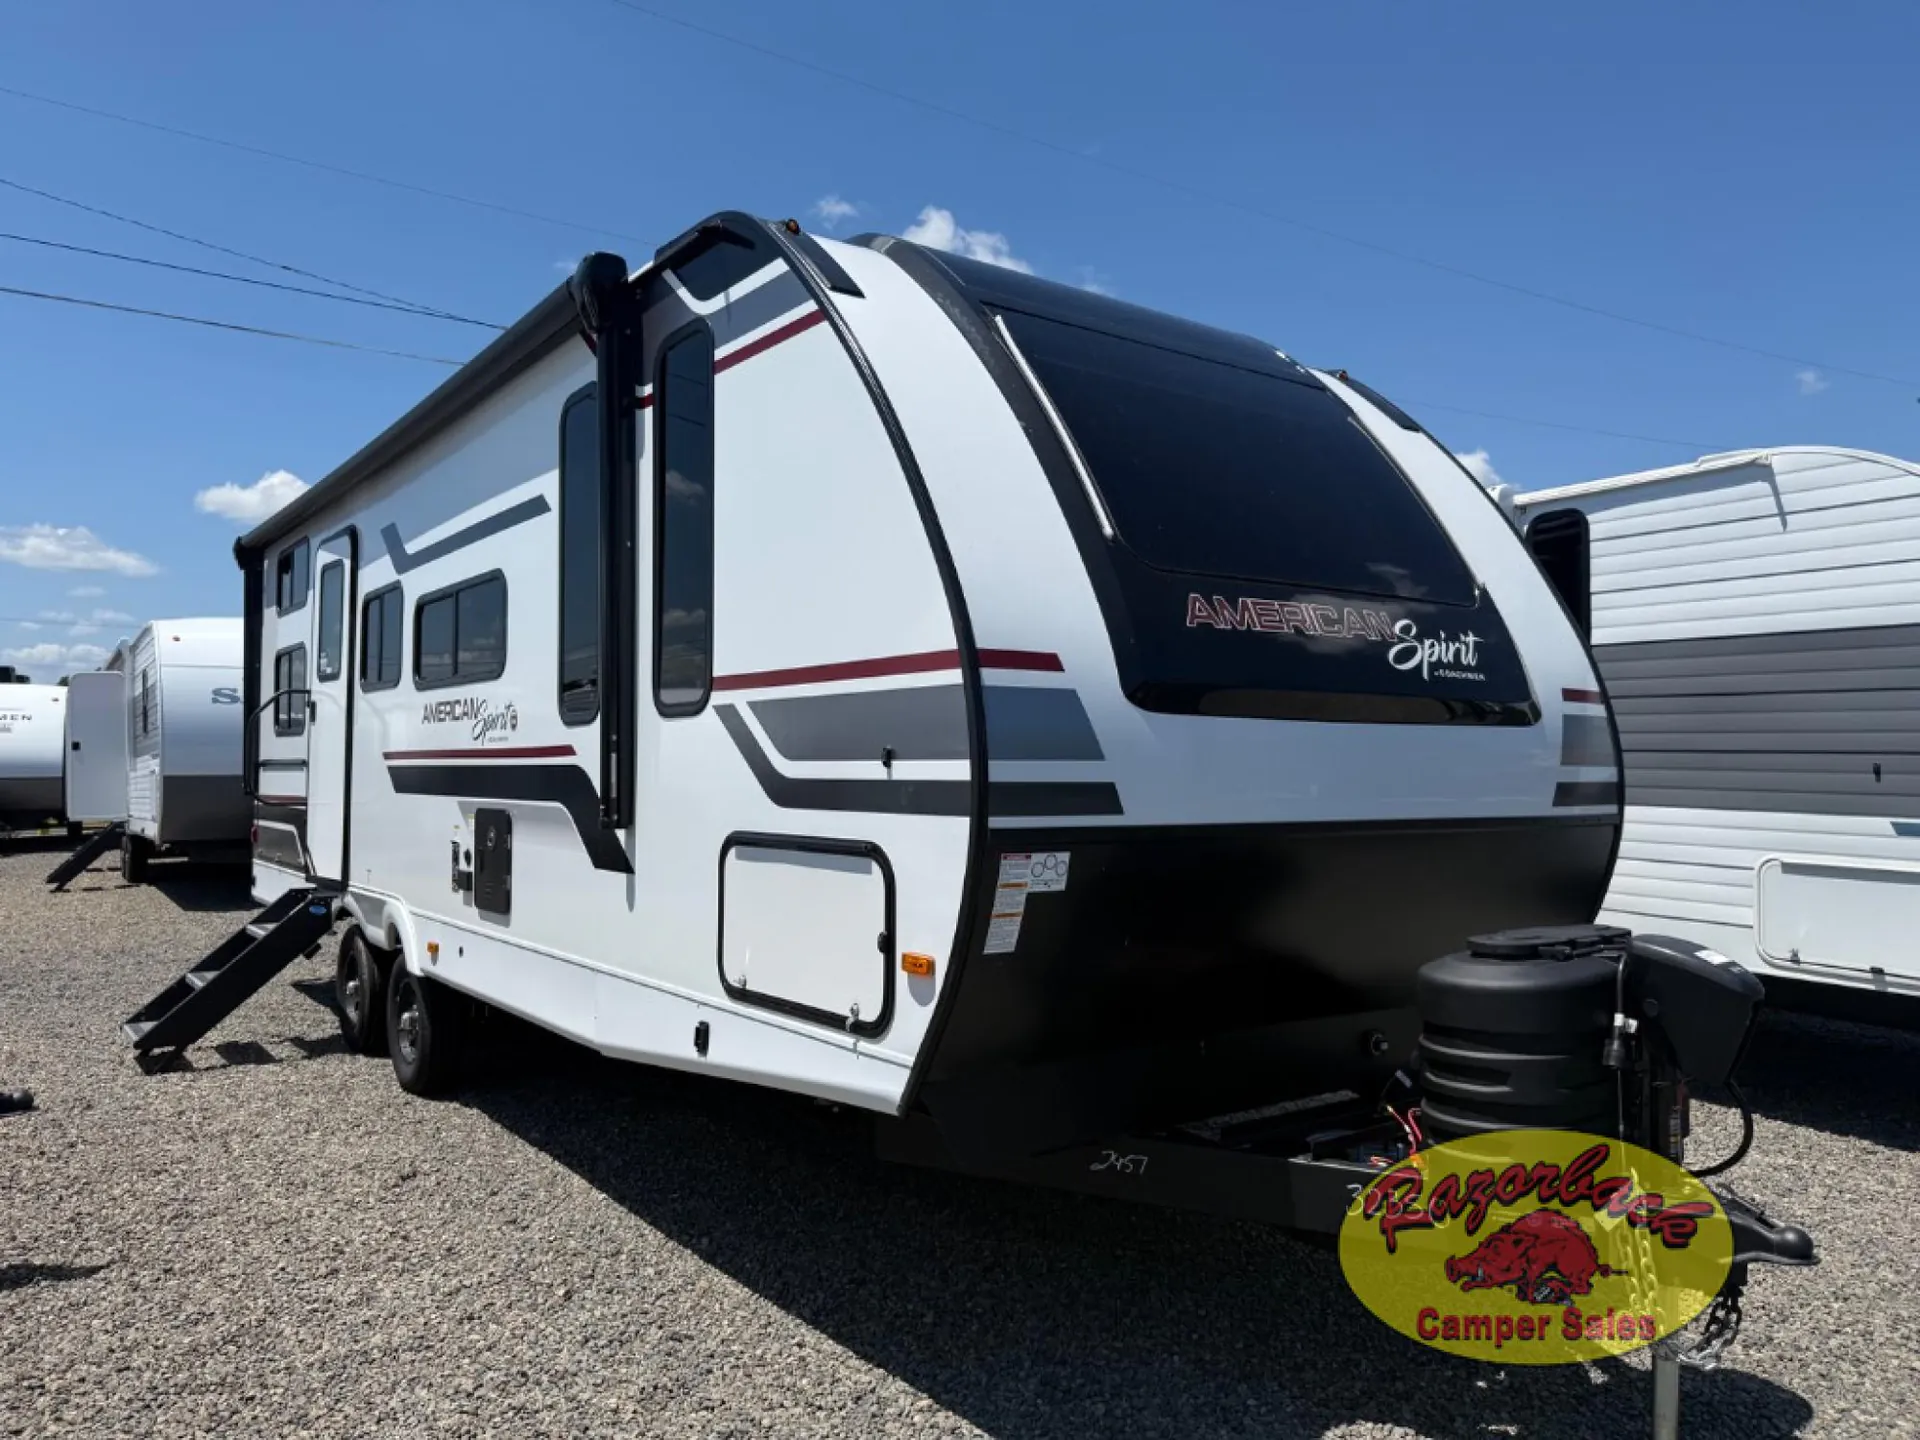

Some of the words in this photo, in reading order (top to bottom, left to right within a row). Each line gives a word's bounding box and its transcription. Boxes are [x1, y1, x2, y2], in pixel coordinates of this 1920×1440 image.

[1186, 593, 1398, 642] AMERICAN
[1388, 618, 1485, 681] Spirit
[421, 696, 482, 725] AMERICAN
